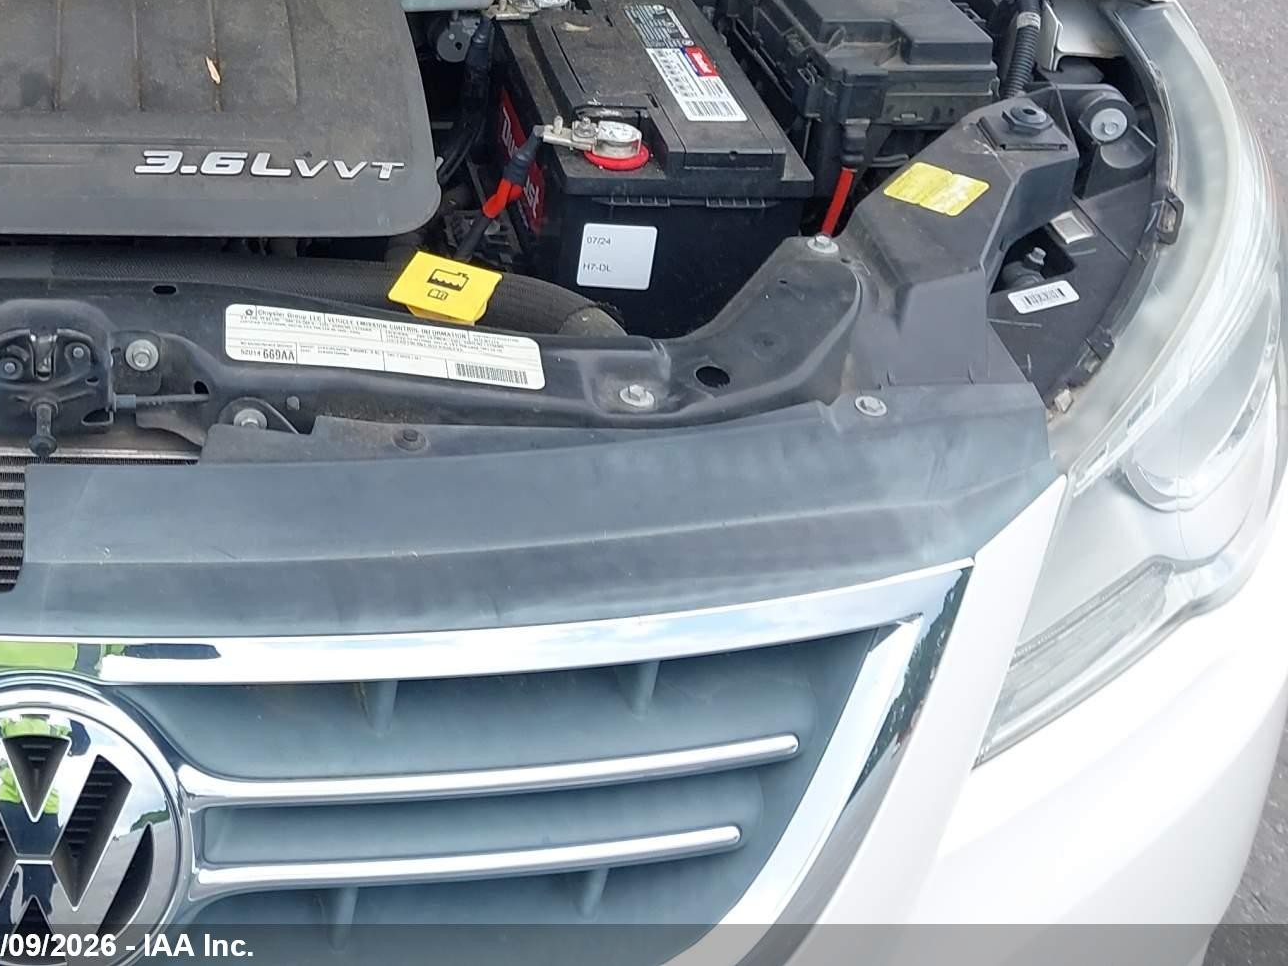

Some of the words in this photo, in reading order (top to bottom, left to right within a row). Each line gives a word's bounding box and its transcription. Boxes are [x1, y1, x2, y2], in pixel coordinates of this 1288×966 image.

[134, 150, 292, 176] 3.6L
[294, 158, 406, 179] VVT
[586, 236, 612, 246] 07/24
[258, 309, 285, 318] Chrysler
[287, 313, 308, 321] Group
[263, 348, 295, 362] 669AA
